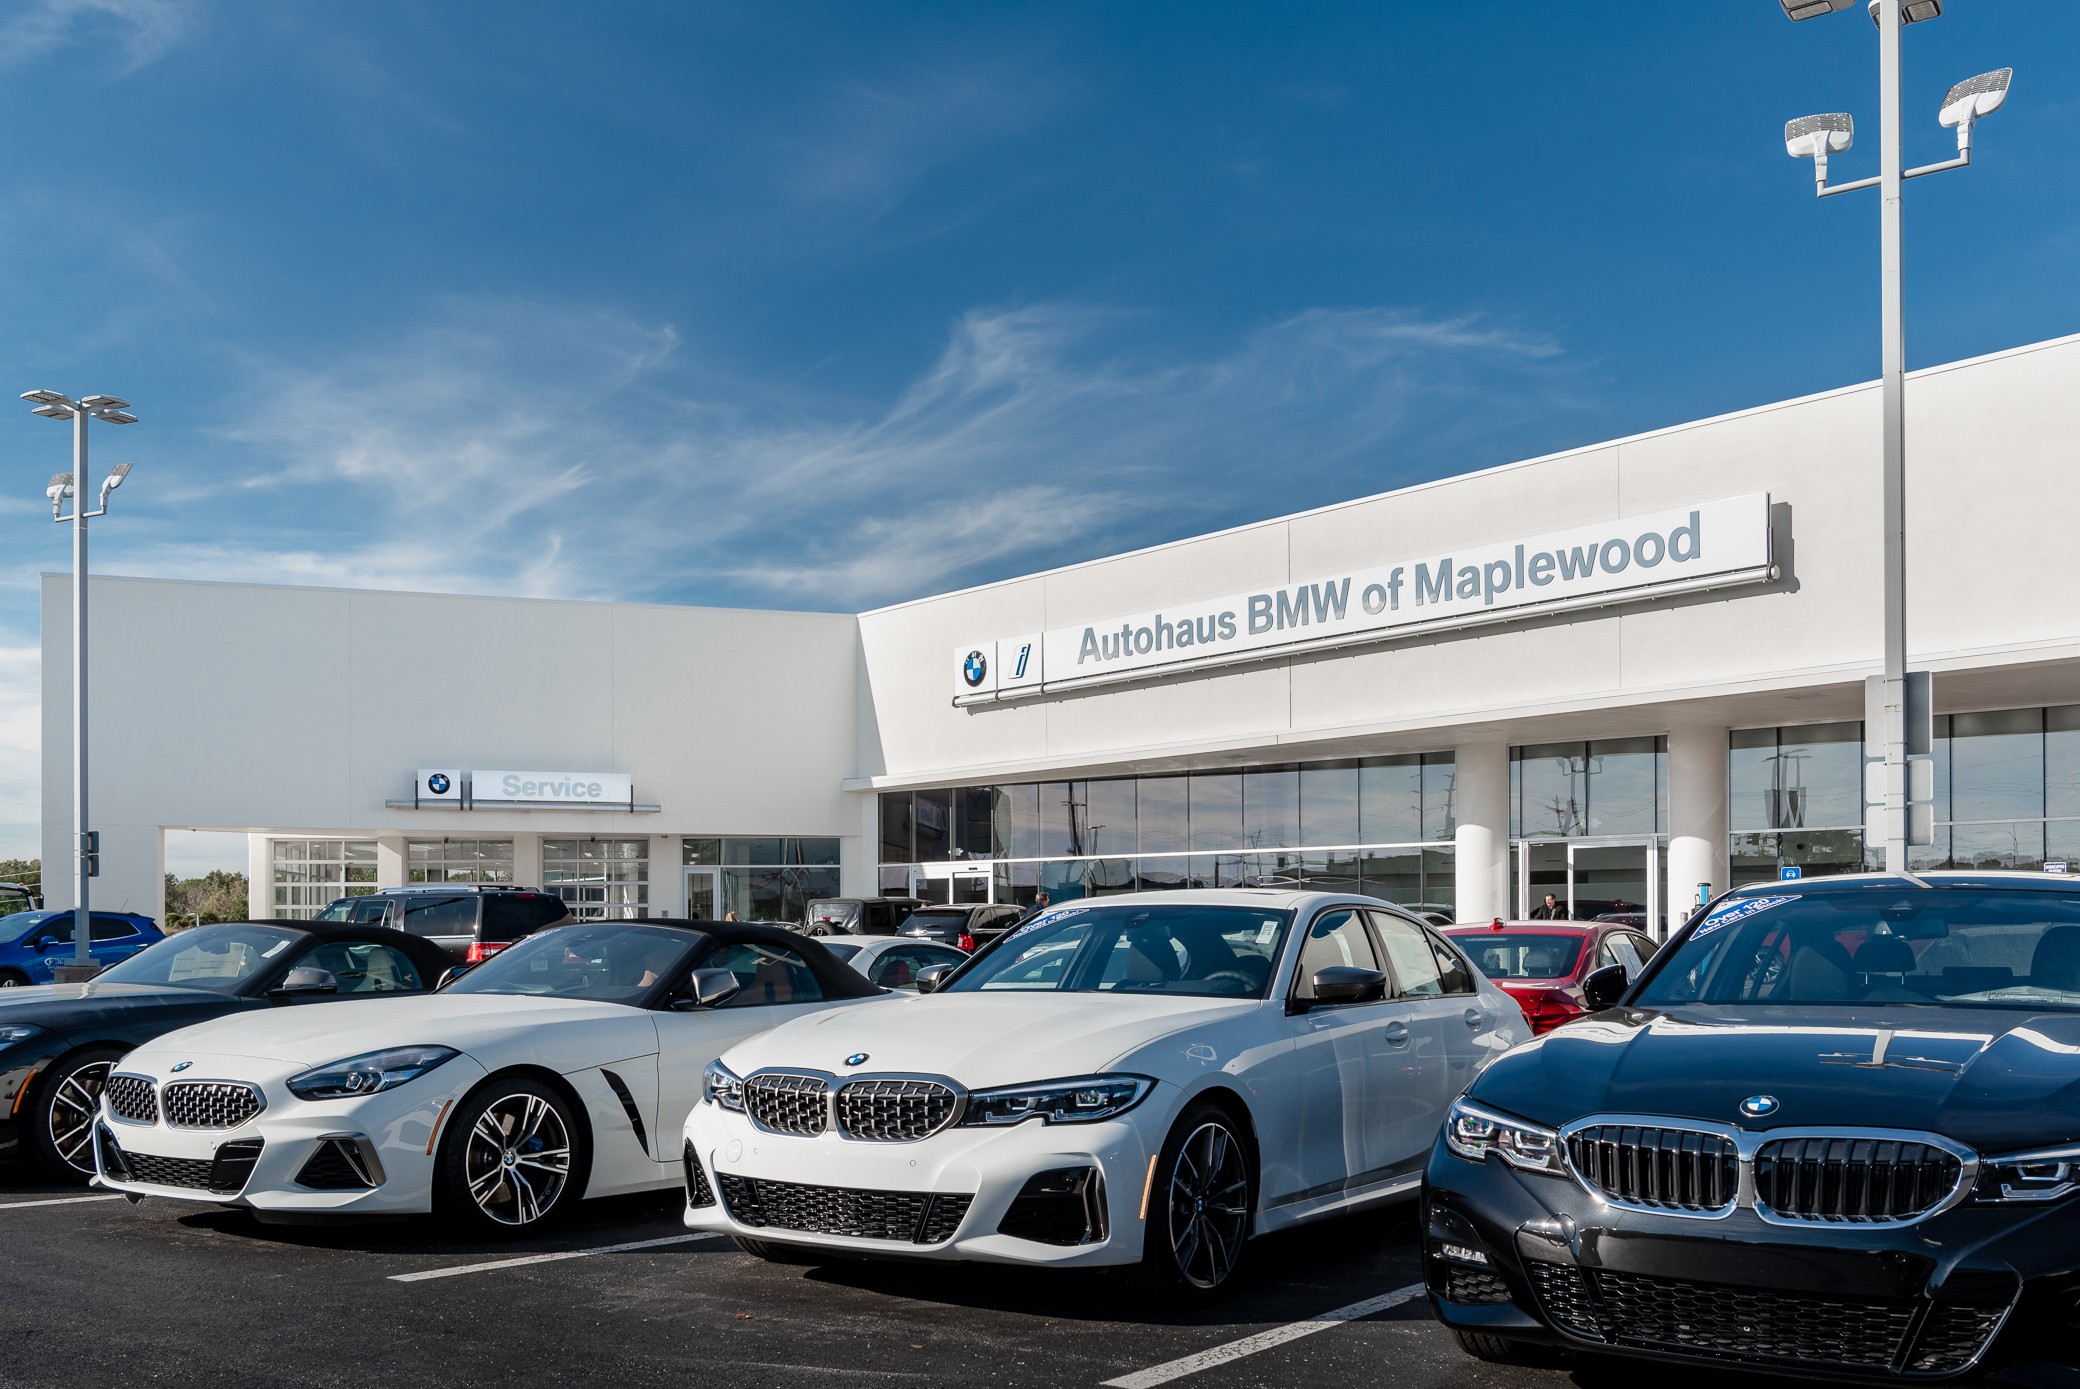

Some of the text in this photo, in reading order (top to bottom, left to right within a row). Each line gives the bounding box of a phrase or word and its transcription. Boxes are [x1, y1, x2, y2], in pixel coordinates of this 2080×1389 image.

[1077, 510, 1701, 665] Autohaus BMW of Maplewood
[502, 774, 602, 798] Service
[1699, 924, 1720, 934] New
[1722, 914, 1744, 926] Cars
[1755, 897, 1787, 912] Stock!
[1705, 898, 1770, 926] Over 120
